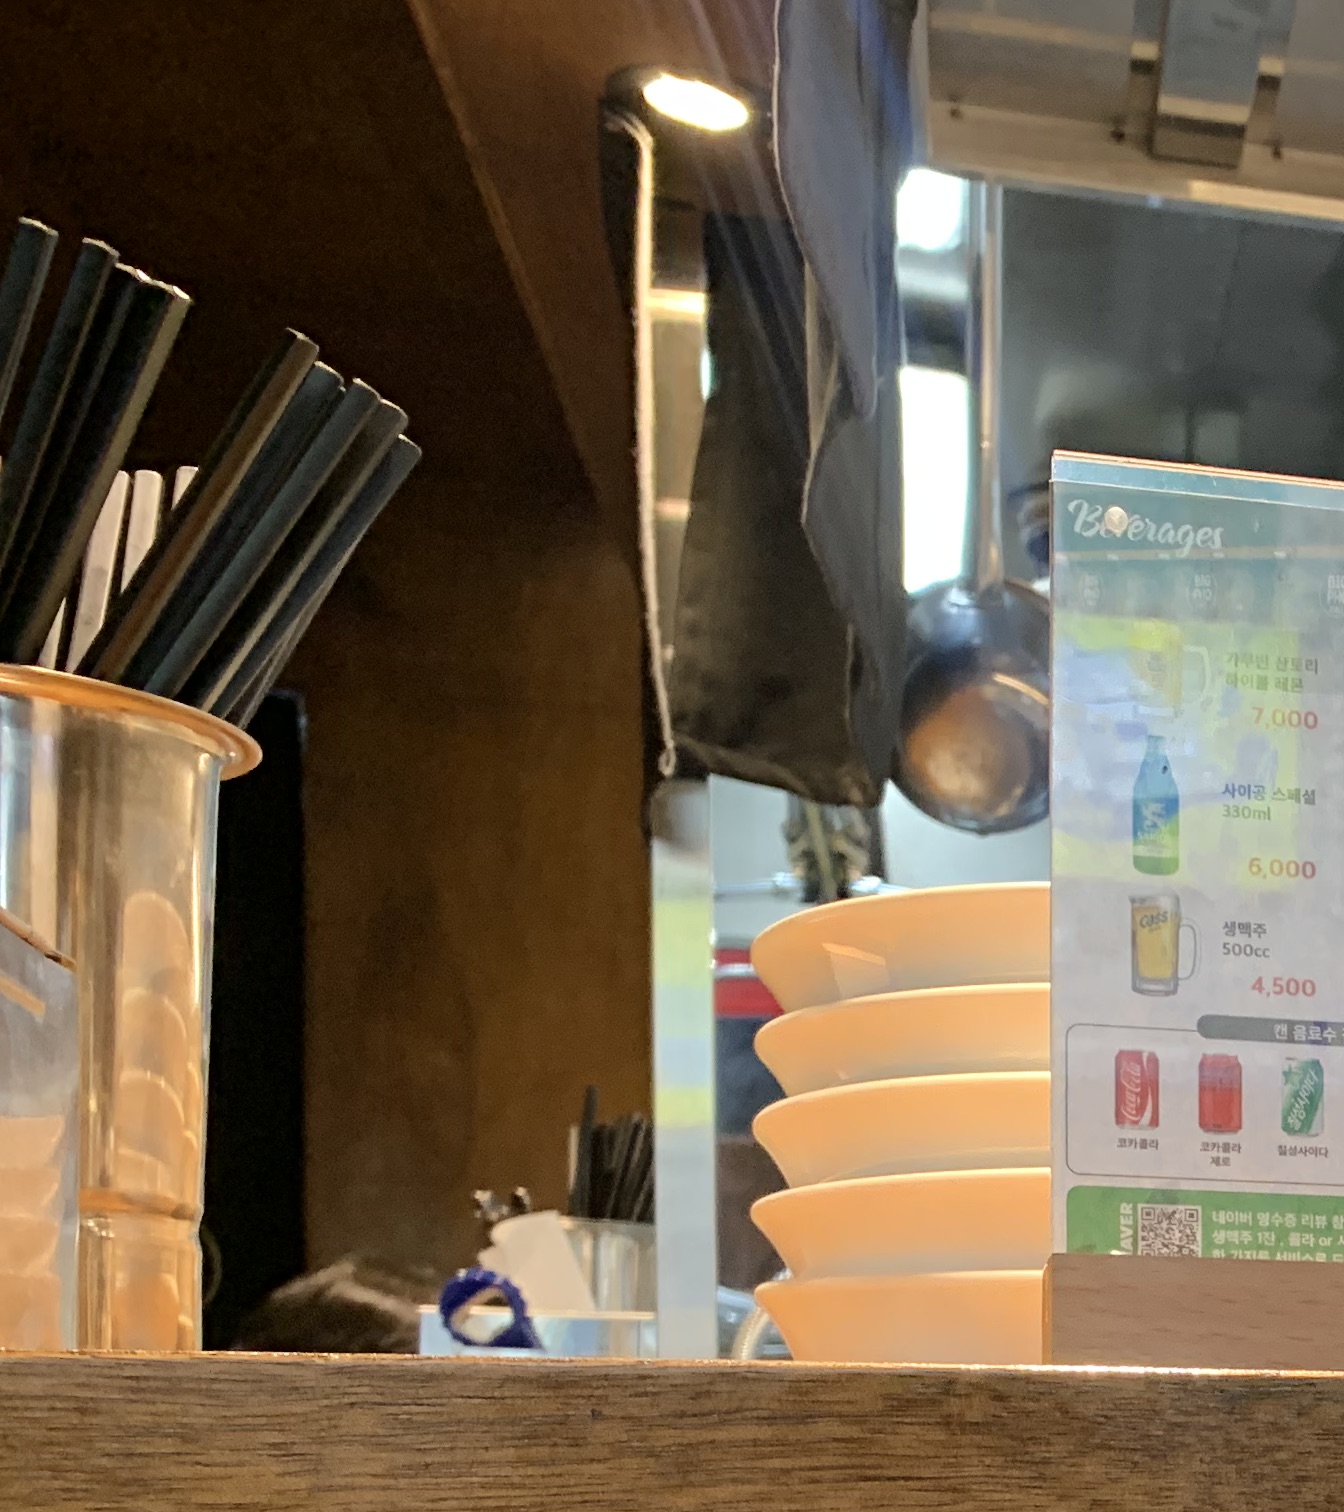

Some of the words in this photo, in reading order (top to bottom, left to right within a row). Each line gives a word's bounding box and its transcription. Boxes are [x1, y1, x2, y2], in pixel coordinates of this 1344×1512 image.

[1252, 706, 1319, 730] 7,000
[1222, 783, 1266, 801] 사이공
[1271, 787, 1316, 805] 스페셜
[1222, 804, 1272, 821] 330ml
[1248, 857, 1317, 880] 6,000
[1222, 920, 1268, 939] 생맥주
[1222, 942, 1271, 959] 500cc
[1250, 976, 1317, 998] 4,500
[1274, 1023, 1289, 1040] 캔
[1293, 1025, 1337, 1043] 음료수
[1117, 1137, 1160, 1150] 코카콜라
[1200, 1141, 1242, 1154] 코카콜라
[1277, 1144, 1329, 1158] 칠성사이다
[1210, 1156, 1231, 1167] 제로
[1119, 1203, 1133, 1255] AVER
[1212, 1211, 1252, 1226] 네이버
[1257, 1212, 1297, 1228] 영수증
[1301, 1214, 1327, 1229] 리뷰
[1212, 1229, 1253, 1245] 생맥주
[1257, 1231, 1275, 1246] 1잔
[1289, 1232, 1316, 1248] 콜라
[1318, 1237, 1333, 1247] or
